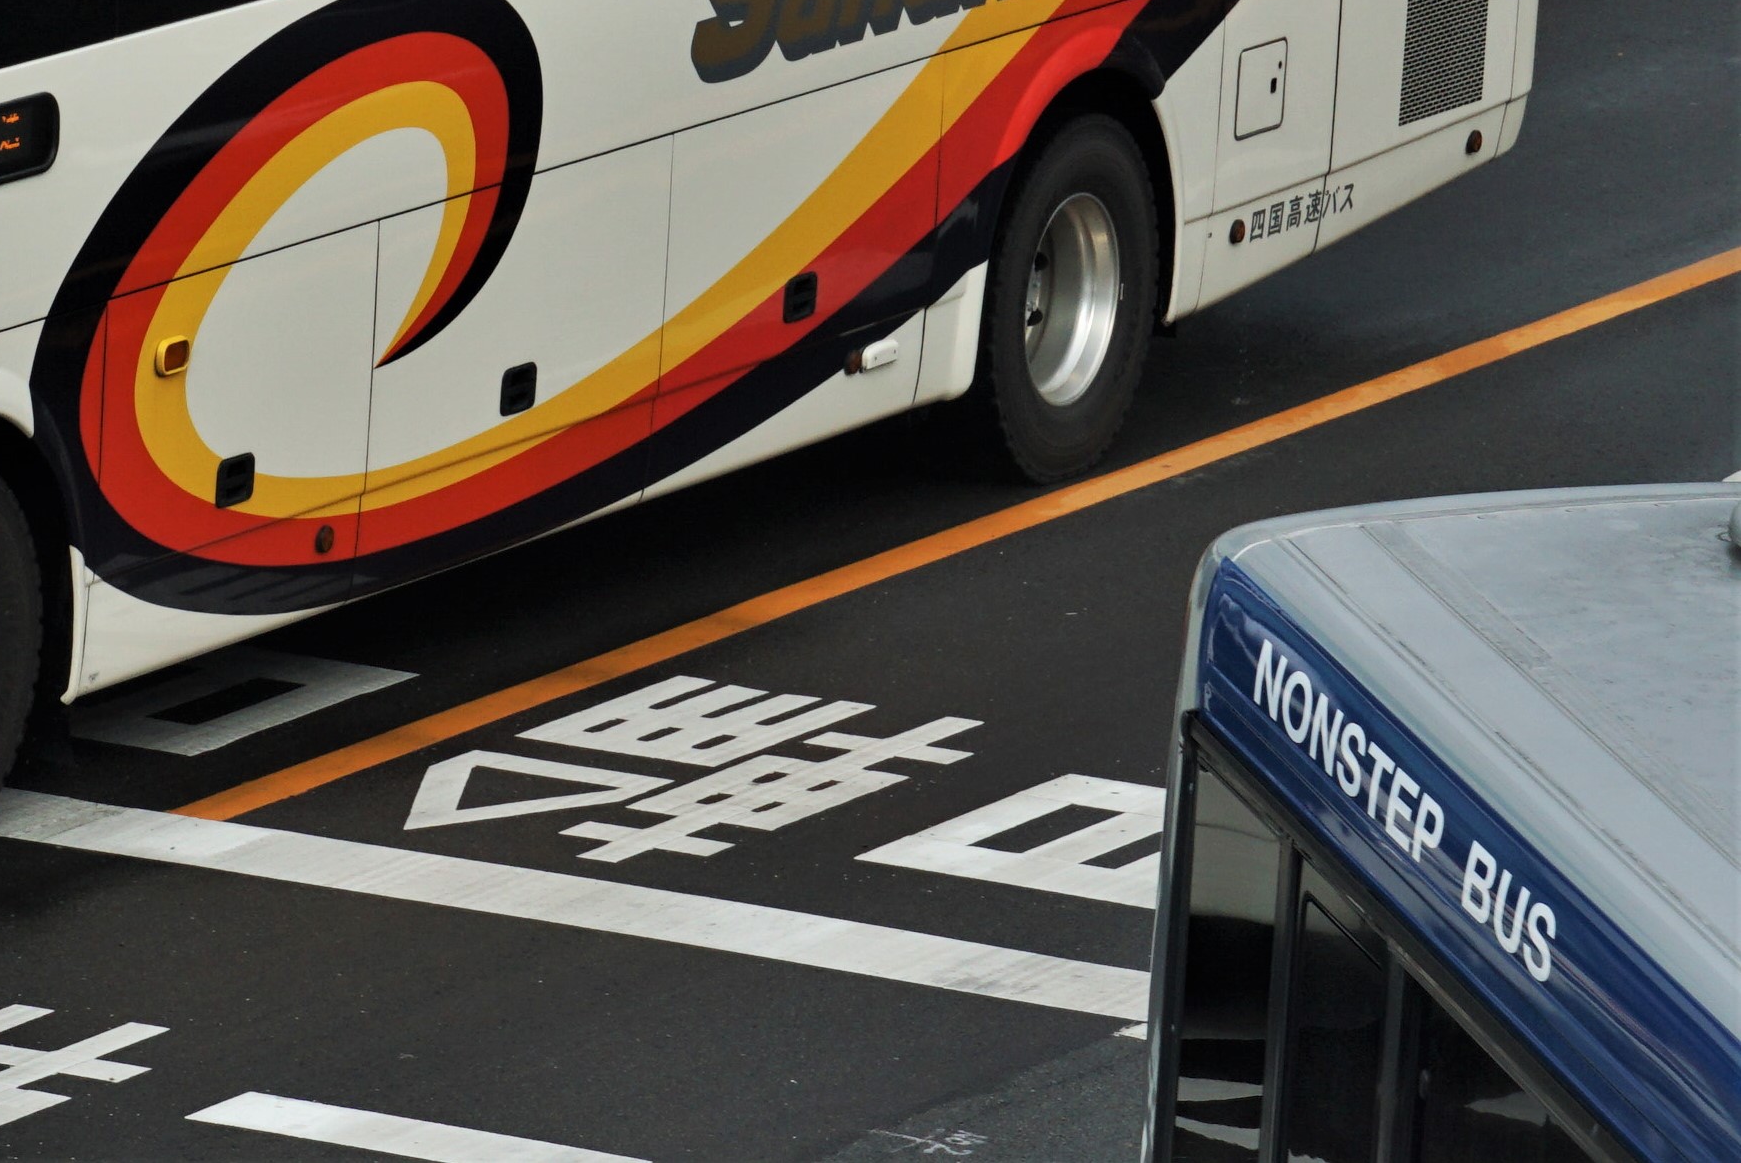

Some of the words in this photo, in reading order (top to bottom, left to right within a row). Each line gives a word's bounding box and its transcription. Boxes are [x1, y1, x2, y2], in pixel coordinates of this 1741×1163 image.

[1249, 183, 1355, 243] 四国高速バス
[1253, 639, 1446, 863] NONSTEP
[1460, 840, 1557, 983] BUS
